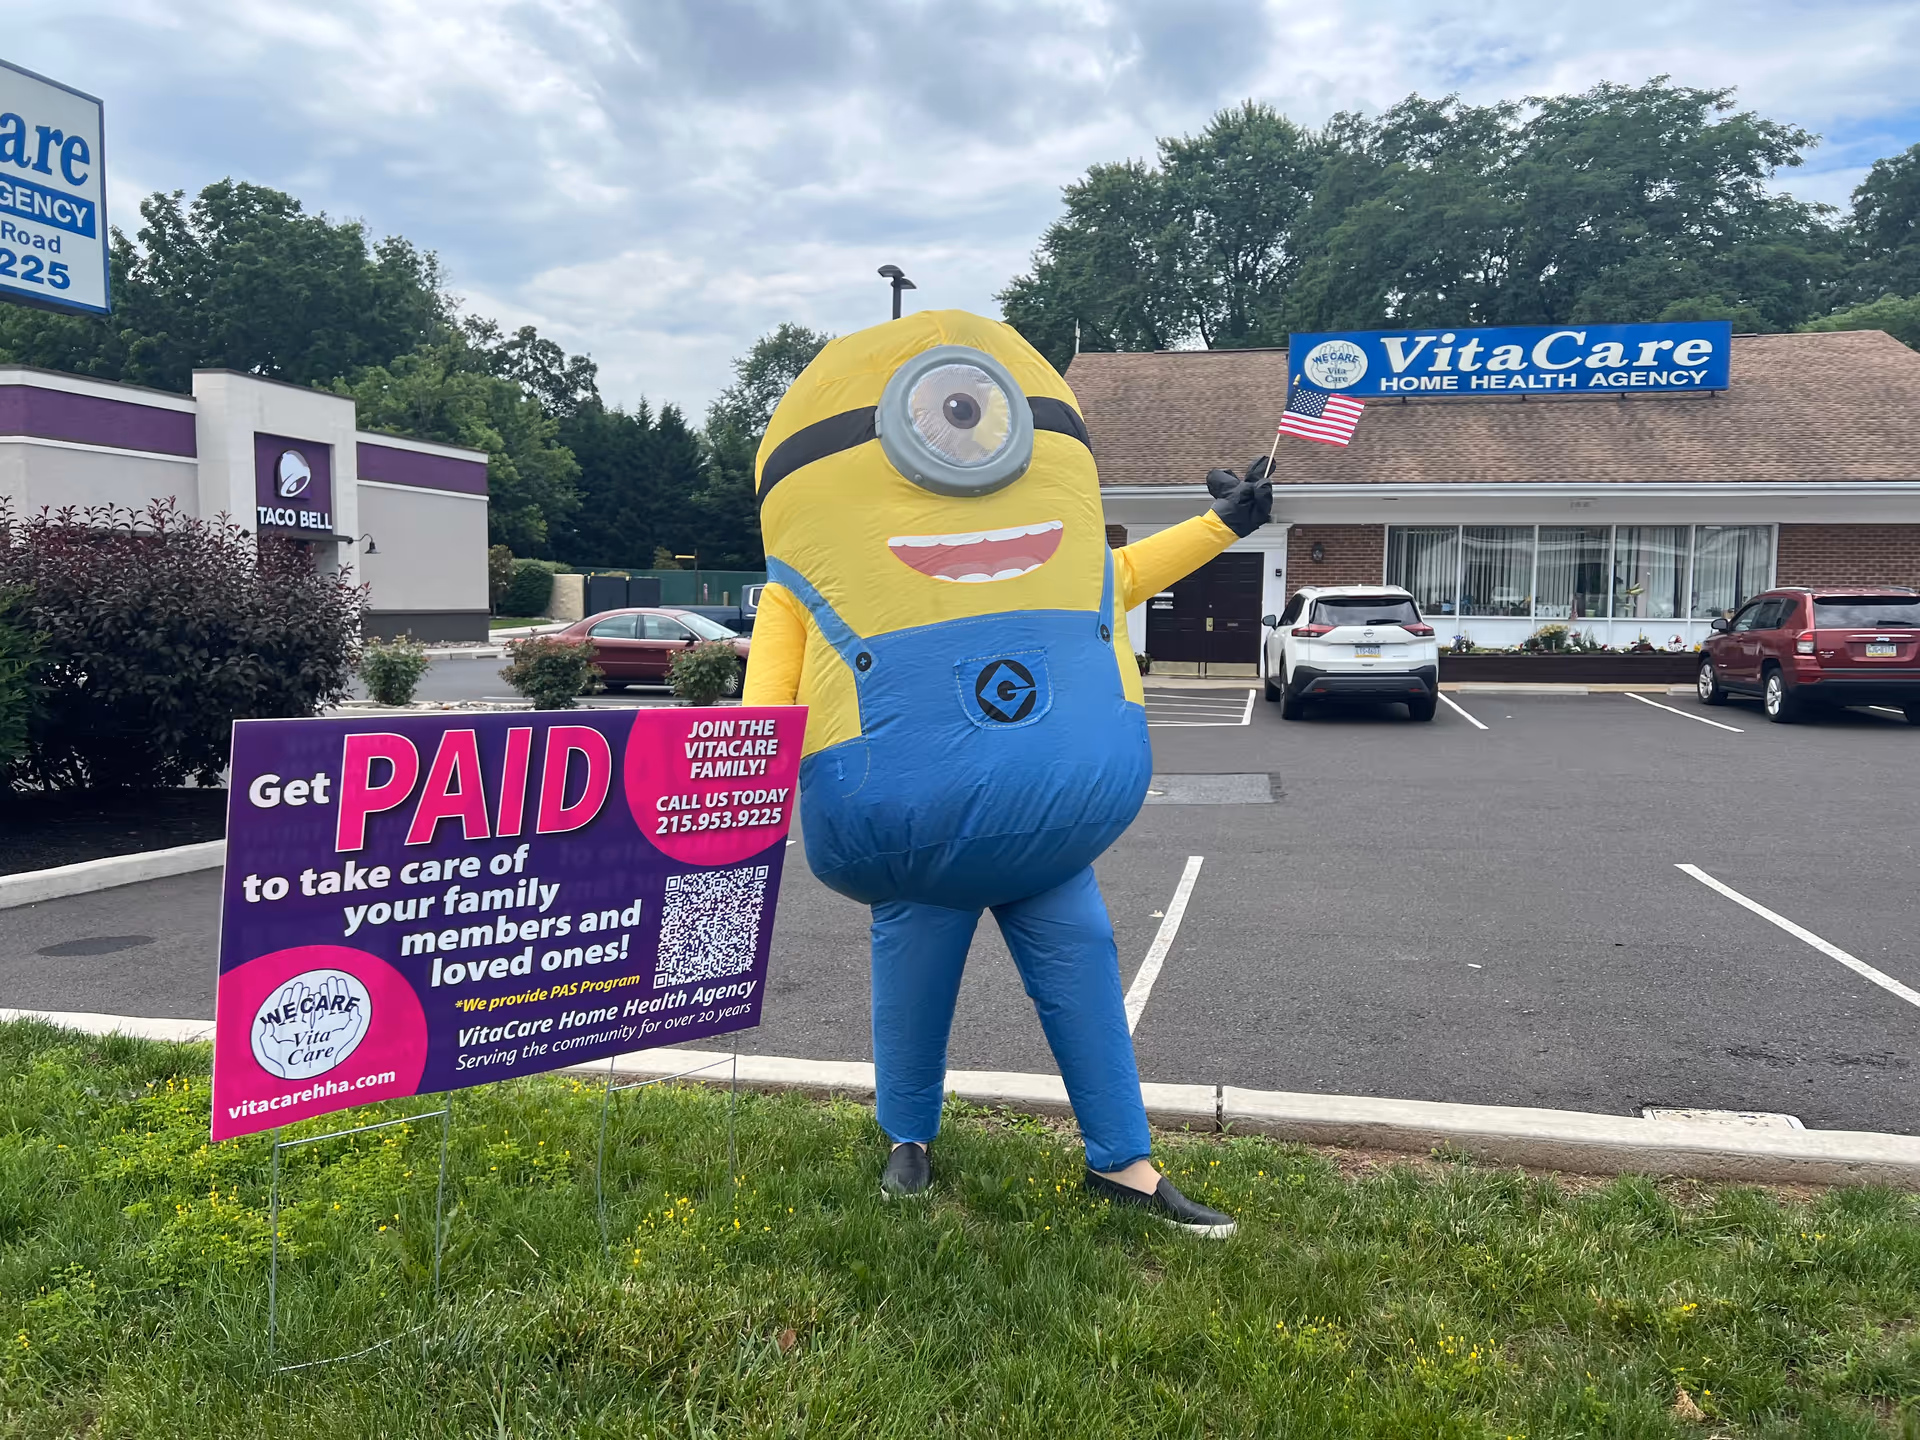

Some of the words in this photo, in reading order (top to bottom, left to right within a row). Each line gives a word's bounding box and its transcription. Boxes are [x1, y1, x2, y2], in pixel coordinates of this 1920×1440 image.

[1, 220, 61, 254] Road
[1312, 353, 1329, 364] WE
[1330, 352, 1360, 363] CARE
[1379, 330, 1714, 374] VitaCare
[1325, 375, 1349, 384] Care
[1328, 367, 1347, 375] Vita
[1380, 375, 1459, 392] HOME
[1471, 372, 1577, 389] HEALTH
[1588, 369, 1708, 388] AGENCY
[257, 506, 296, 527] TACO
[300, 510, 333, 530] BELL
[687, 720, 735, 739] JOIN
[738, 719, 776, 737] THE
[684, 739, 778, 759] VITACARE
[690, 759, 767, 779] FAMILY!
[249, 771, 331, 808] Get
[335, 725, 612, 853] PAID
[656, 793, 701, 812] CALL
[705, 791, 729, 808] US
[732, 788, 789, 806] TODAY
[655, 807, 782, 835] 215.953.9225
[242, 873, 290, 903] to
[300, 861, 391, 897] take
[399, 854, 482, 885] care
[489, 843, 530, 876] of
[343, 894, 436, 937] your
[442, 877, 560, 916] family
[400, 913, 572, 957] members
[578, 898, 642, 933] and
[430, 946, 533, 988] loved
[540, 934, 631, 973] ones!
[488, 988, 548, 1012] provide
[550, 982, 578, 999] PAS
[580, 973, 640, 996] Program
[259, 1001, 298, 1026] WE
[300, 994, 361, 1014] CARE
[458, 1015, 554, 1048] VitaCare
[558, 1004, 618, 1030] Home
[622, 990, 689, 1018] Health
[690, 978, 758, 1006] Agency
[293, 1029, 331, 1048] Vita
[455, 1048, 517, 1071] Serving
[521, 1041, 549, 1058] the
[551, 1025, 636, 1052] community
[638, 1020, 662, 1042] for
[664, 1013, 699, 1030] over
[699, 1010, 714, 1024] 20
[717, 1001, 752, 1024] years
[287, 1046, 335, 1066] Care
[228, 1070, 396, 1120] vitacarehha.com
